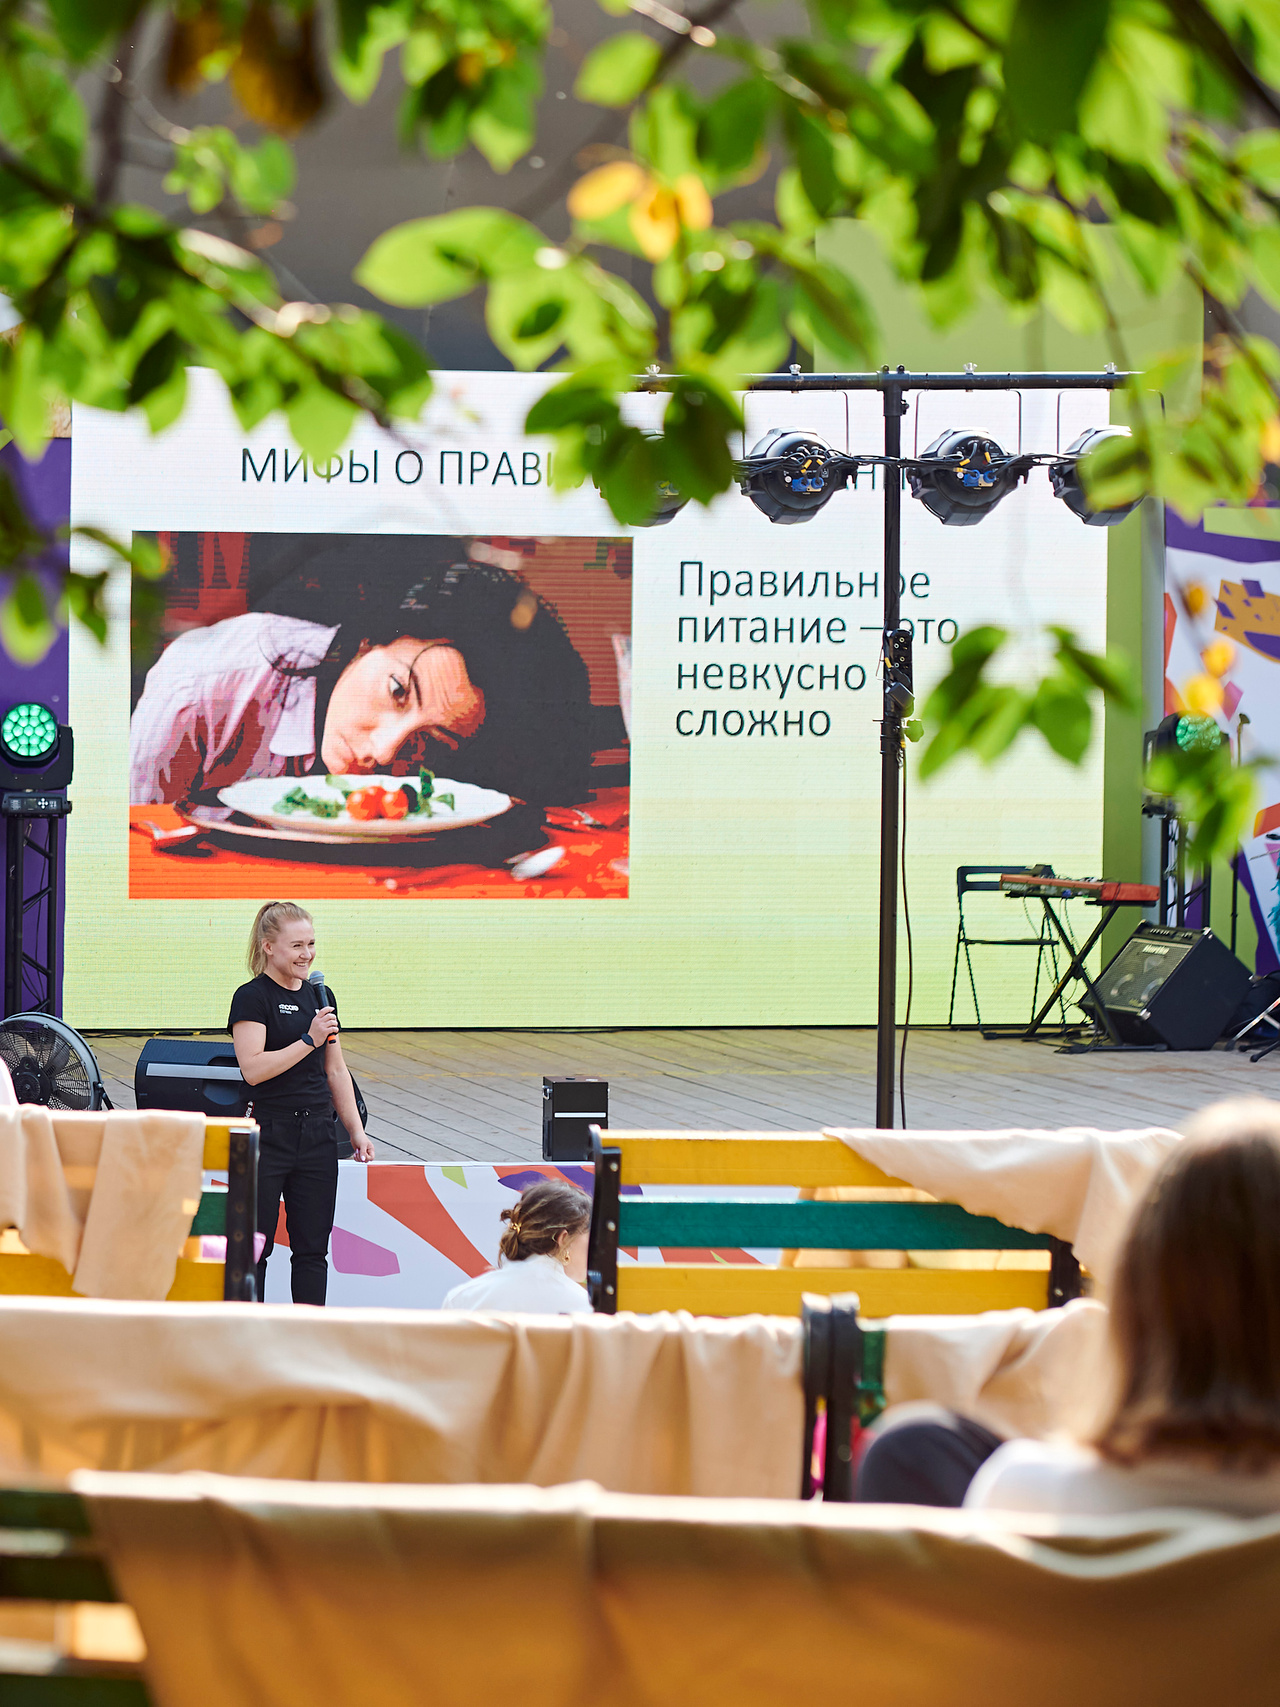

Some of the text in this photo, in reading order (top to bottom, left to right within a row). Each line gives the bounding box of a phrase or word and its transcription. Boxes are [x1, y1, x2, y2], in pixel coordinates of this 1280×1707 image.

[241, 447, 379, 484] МИФЫ
[394, 449, 424, 485] О
[677, 616, 847, 644] питание
[676, 662, 867, 700] невкусно
[675, 708, 832, 737] сложно
